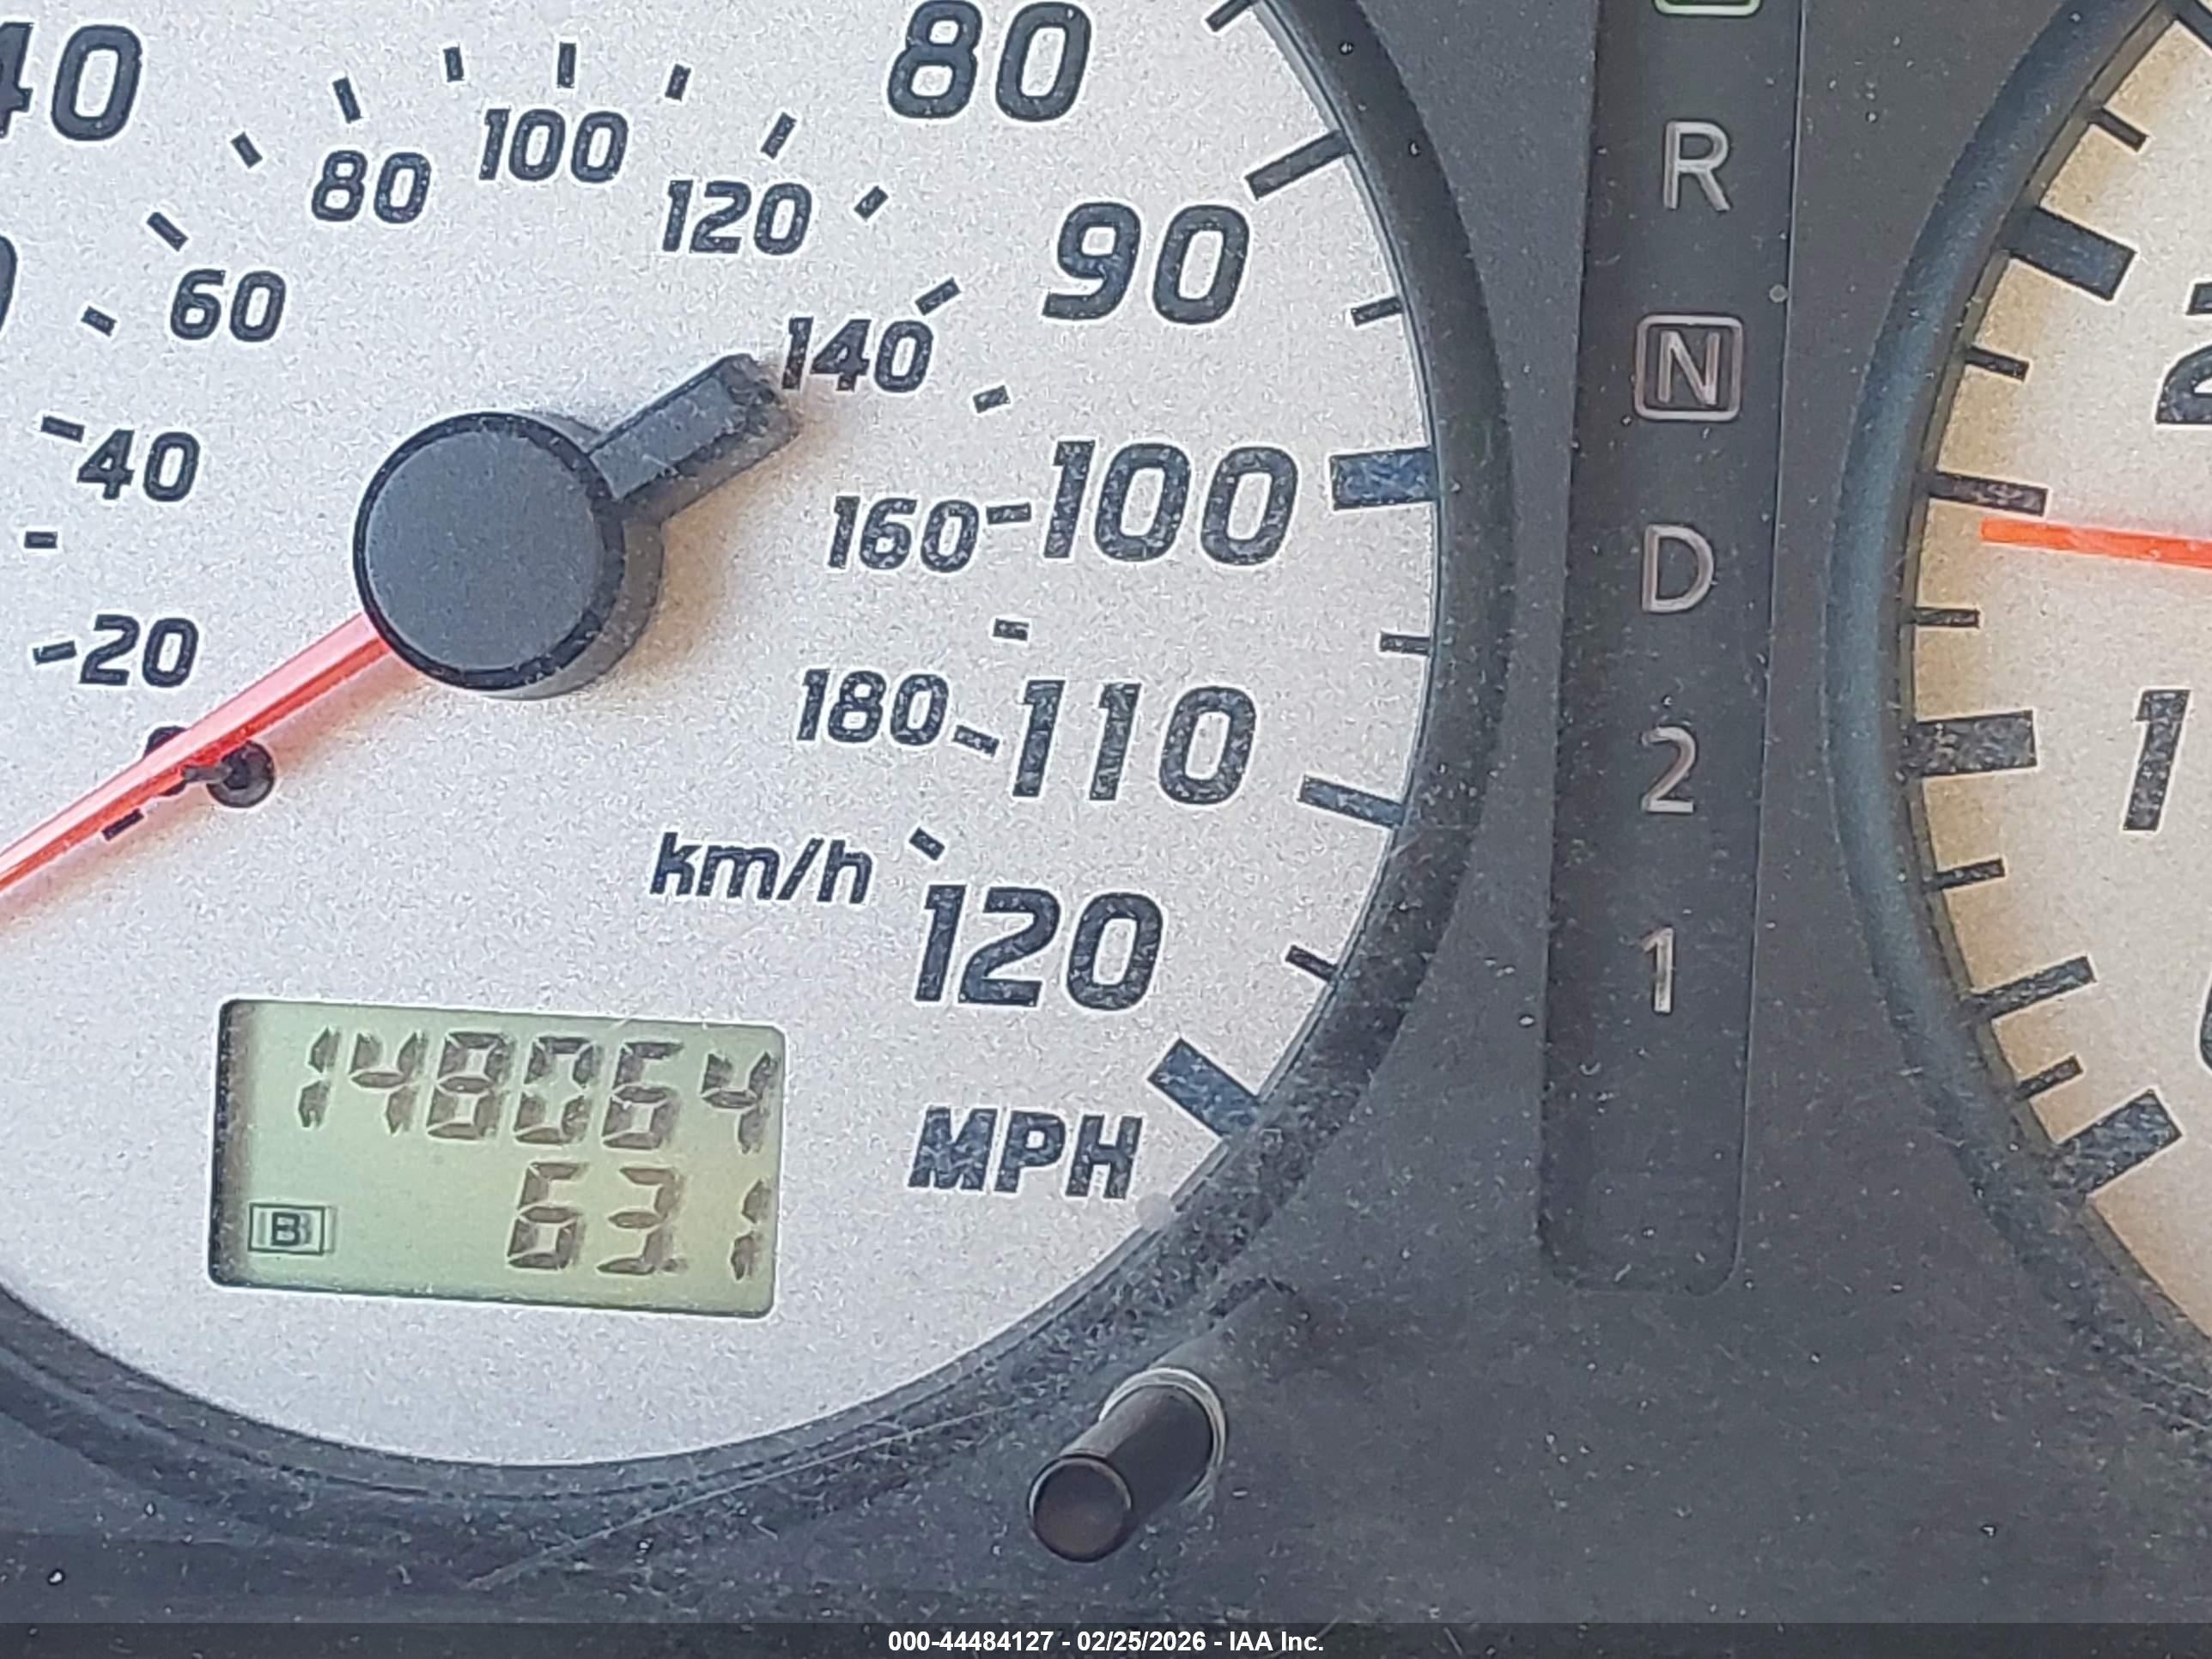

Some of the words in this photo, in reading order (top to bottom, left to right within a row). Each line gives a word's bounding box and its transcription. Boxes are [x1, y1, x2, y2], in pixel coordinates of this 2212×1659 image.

[887, 0, 1091, 121] 80
[312, 150, 430, 223] 80
[479, 109, 629, 182] 100
[1662, 121, 1731, 211] R
[662, 180, 811, 255] 120
[171, 270, 286, 341] 60
[1042, 203, 1249, 325] 90
[781, 318, 933, 392] 140
[1658, 331, 1720, 406] N
[77, 429, 200, 502] 40
[1042, 441, 1298, 565] 100
[828, 495, 979, 573] 160
[1641, 523, 1714, 612] D
[80, 614, 198, 687] 20
[797, 669, 949, 746] 180
[1012, 680, 1256, 805] 110
[1641, 726, 1698, 813] 2
[2124, 690, 2191, 831] 1
[650, 832, 872, 904] km/h
[915, 885, 1163, 1011] 120
[1642, 927, 1674, 1013] 1
[298, 1028, 775, 1155] 148064
[908, 1106, 1142, 1199] MPH
